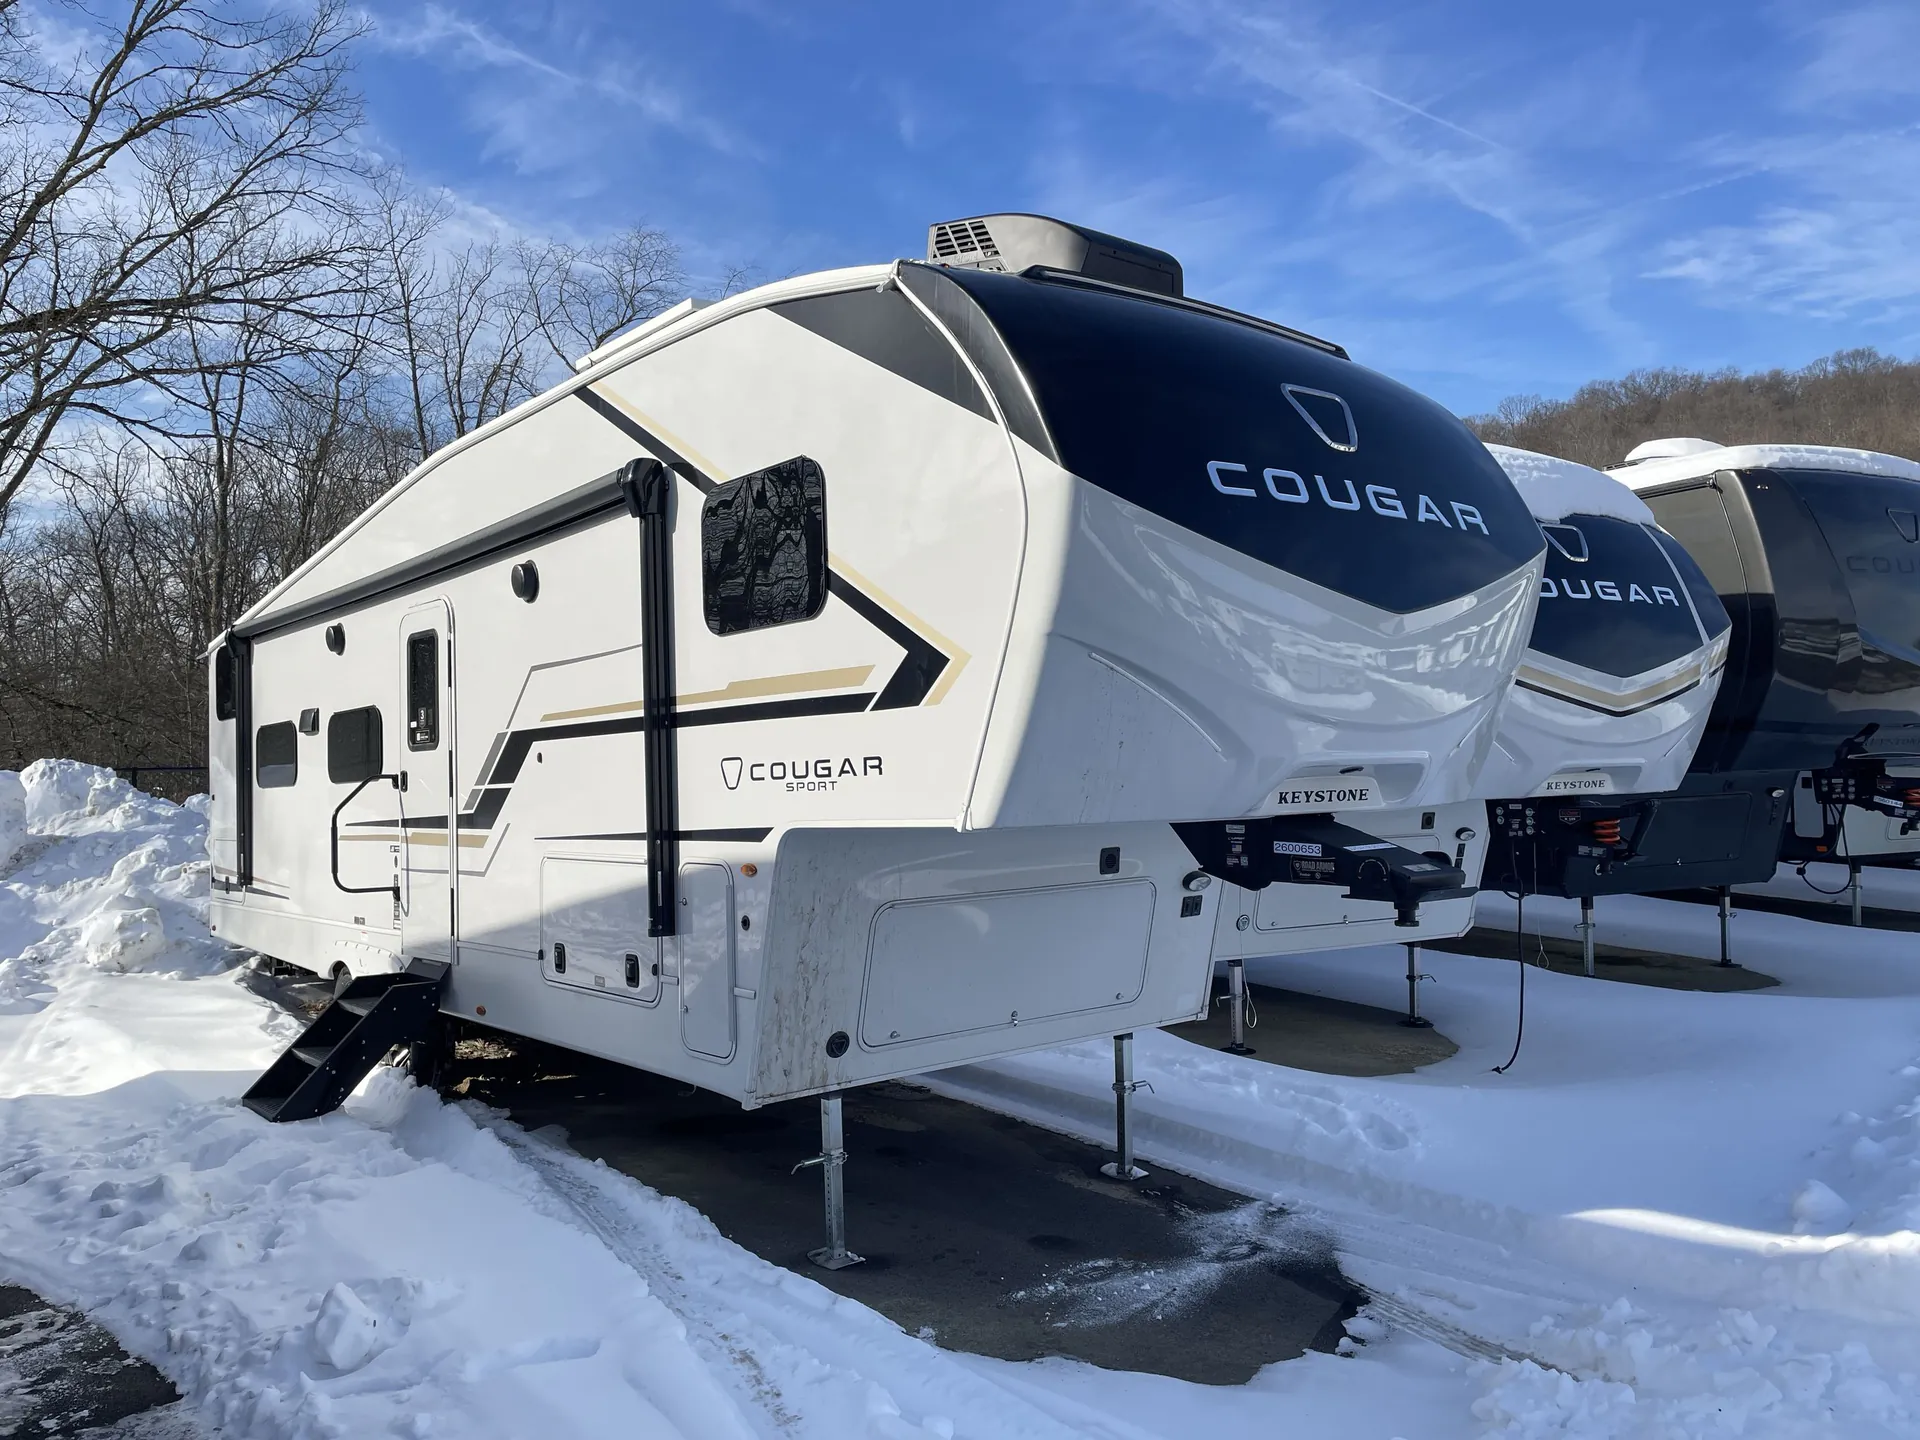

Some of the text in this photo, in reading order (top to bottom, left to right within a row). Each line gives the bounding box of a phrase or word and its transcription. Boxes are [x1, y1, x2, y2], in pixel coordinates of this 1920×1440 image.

[1206, 460, 1490, 535] COUGAR
[1846, 555, 1920, 574] COU
[1539, 577, 1680, 607] OUGAR
[750, 756, 883, 781] COUGAR
[785, 781, 838, 792] SPORT
[1546, 779, 1606, 790] KEYSTONE
[1277, 788, 1369, 805] KEYSTONE
[1274, 842, 1321, 854] 2600653
